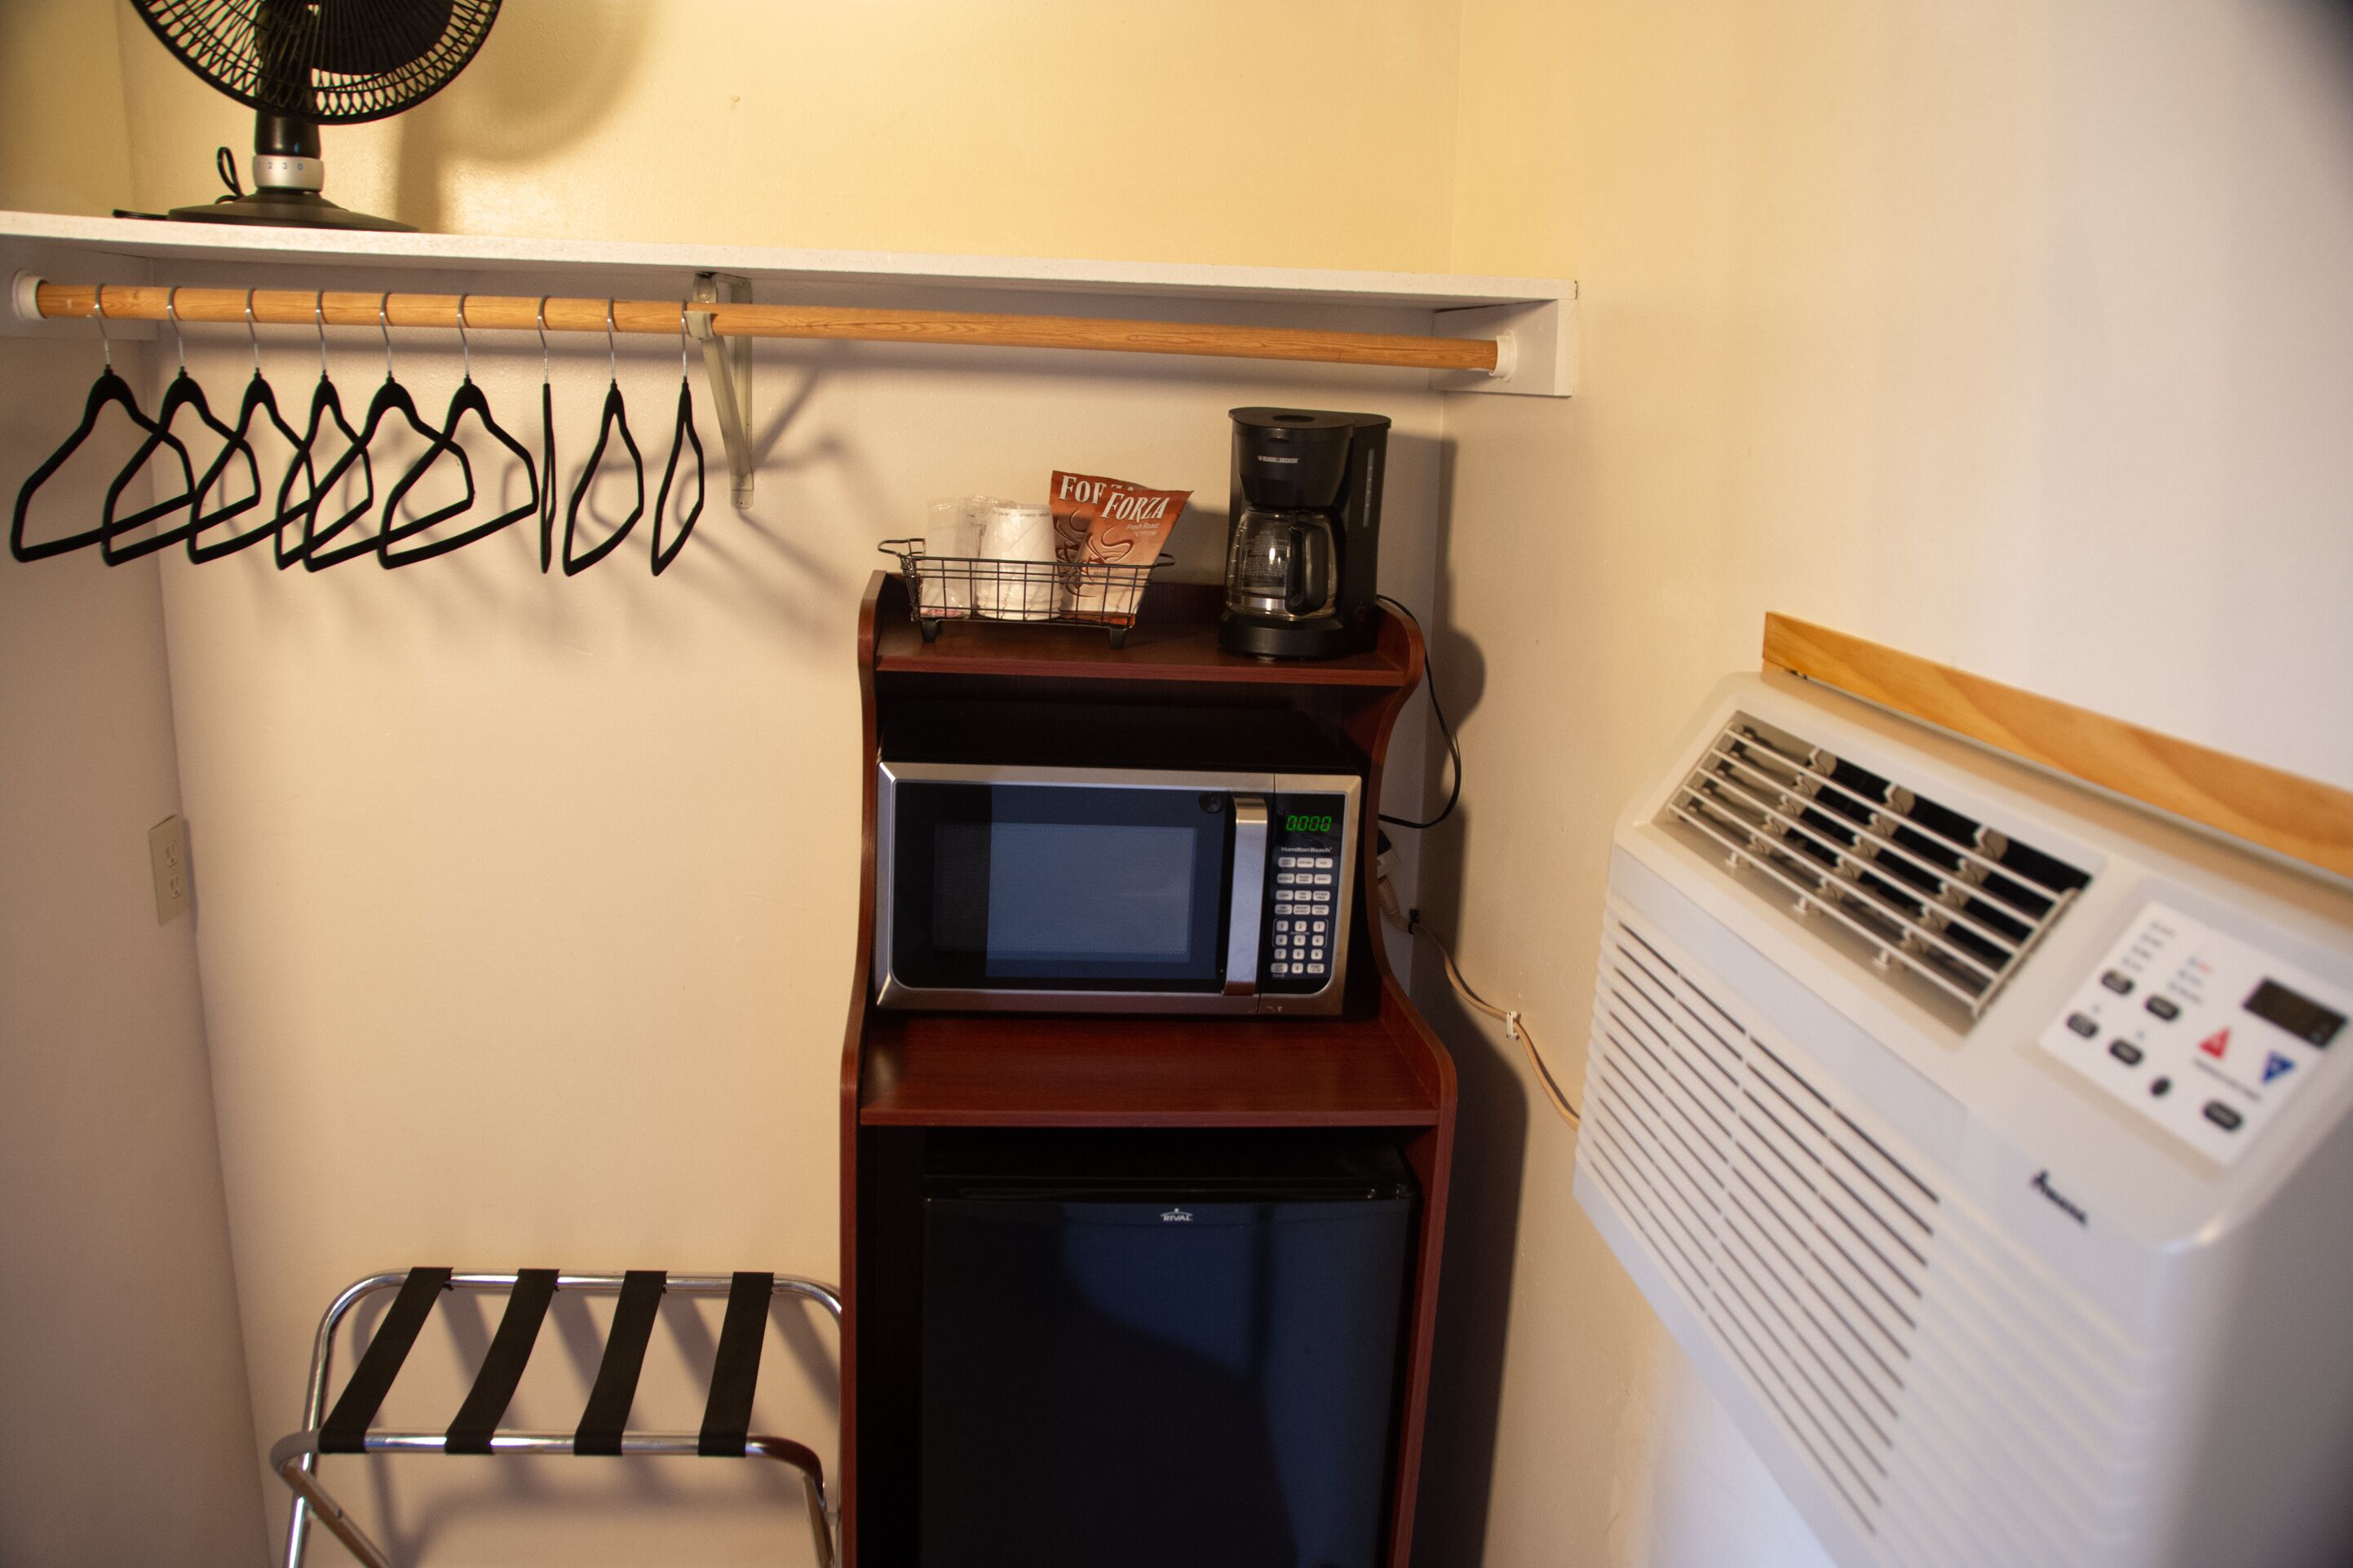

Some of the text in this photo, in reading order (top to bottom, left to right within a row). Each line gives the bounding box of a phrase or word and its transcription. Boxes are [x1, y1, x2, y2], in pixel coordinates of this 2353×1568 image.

[268, 161, 273, 170] 2
[282, 161, 287, 170] 3
[1100, 492, 1170, 523] FORZA
